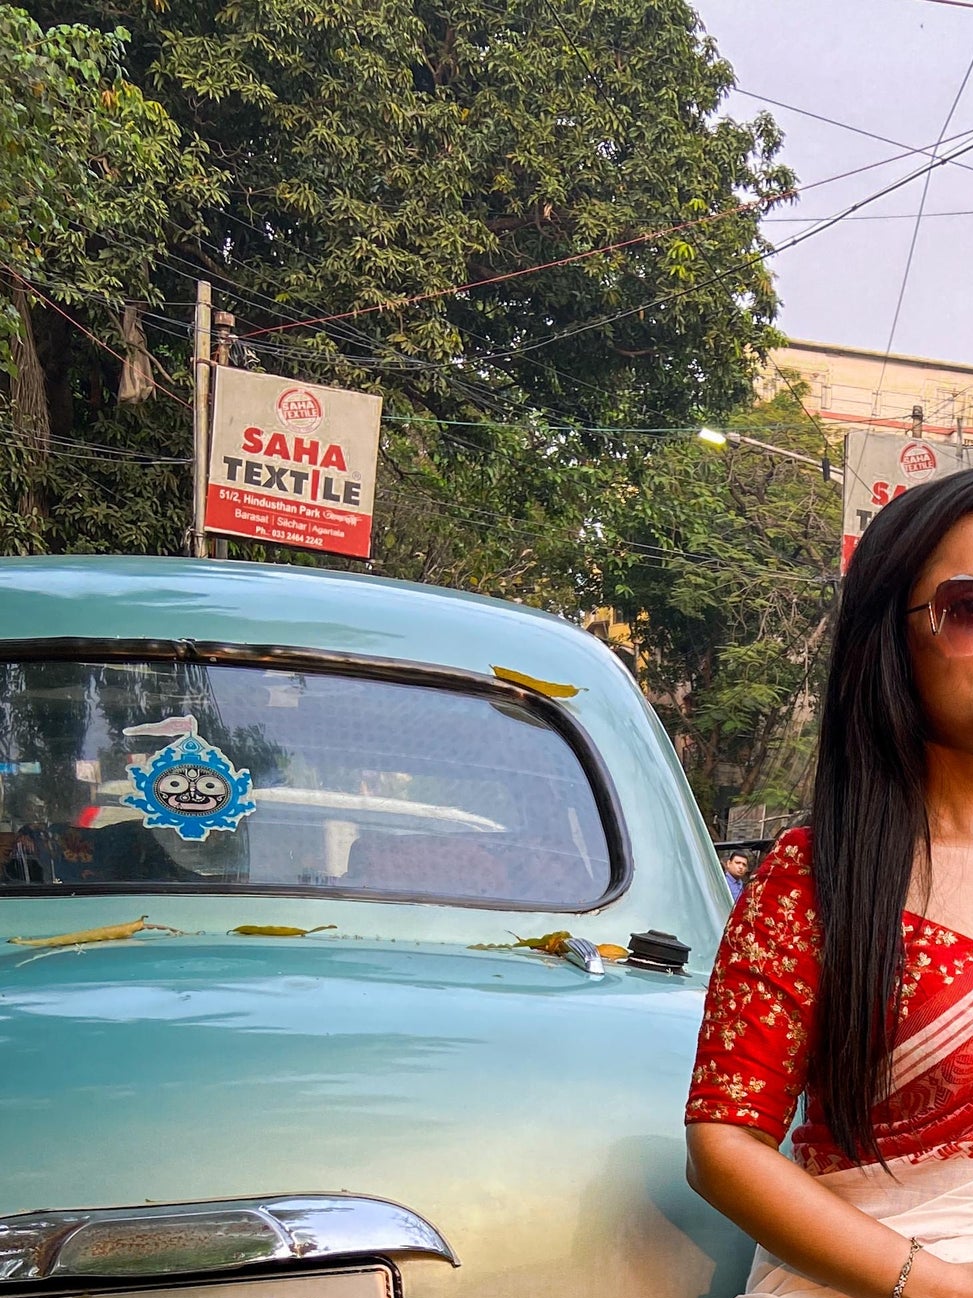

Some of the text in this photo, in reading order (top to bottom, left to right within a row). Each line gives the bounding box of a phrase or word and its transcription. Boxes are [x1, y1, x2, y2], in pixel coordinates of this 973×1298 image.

[282, 401, 315, 411] SAHA
[242, 427, 347, 472] SAHA
[903, 453, 930, 463] SAHA
[903, 461, 934, 473] TEXTILE
[223, 456, 361, 506] TEXTILE
[219, 489, 241, 504] 51/2,
[244, 494, 297, 514] Hindusthan
[299, 506, 321, 519] Park
[235, 508, 269, 524] Barasat
[277, 516, 307, 531] Silchar
